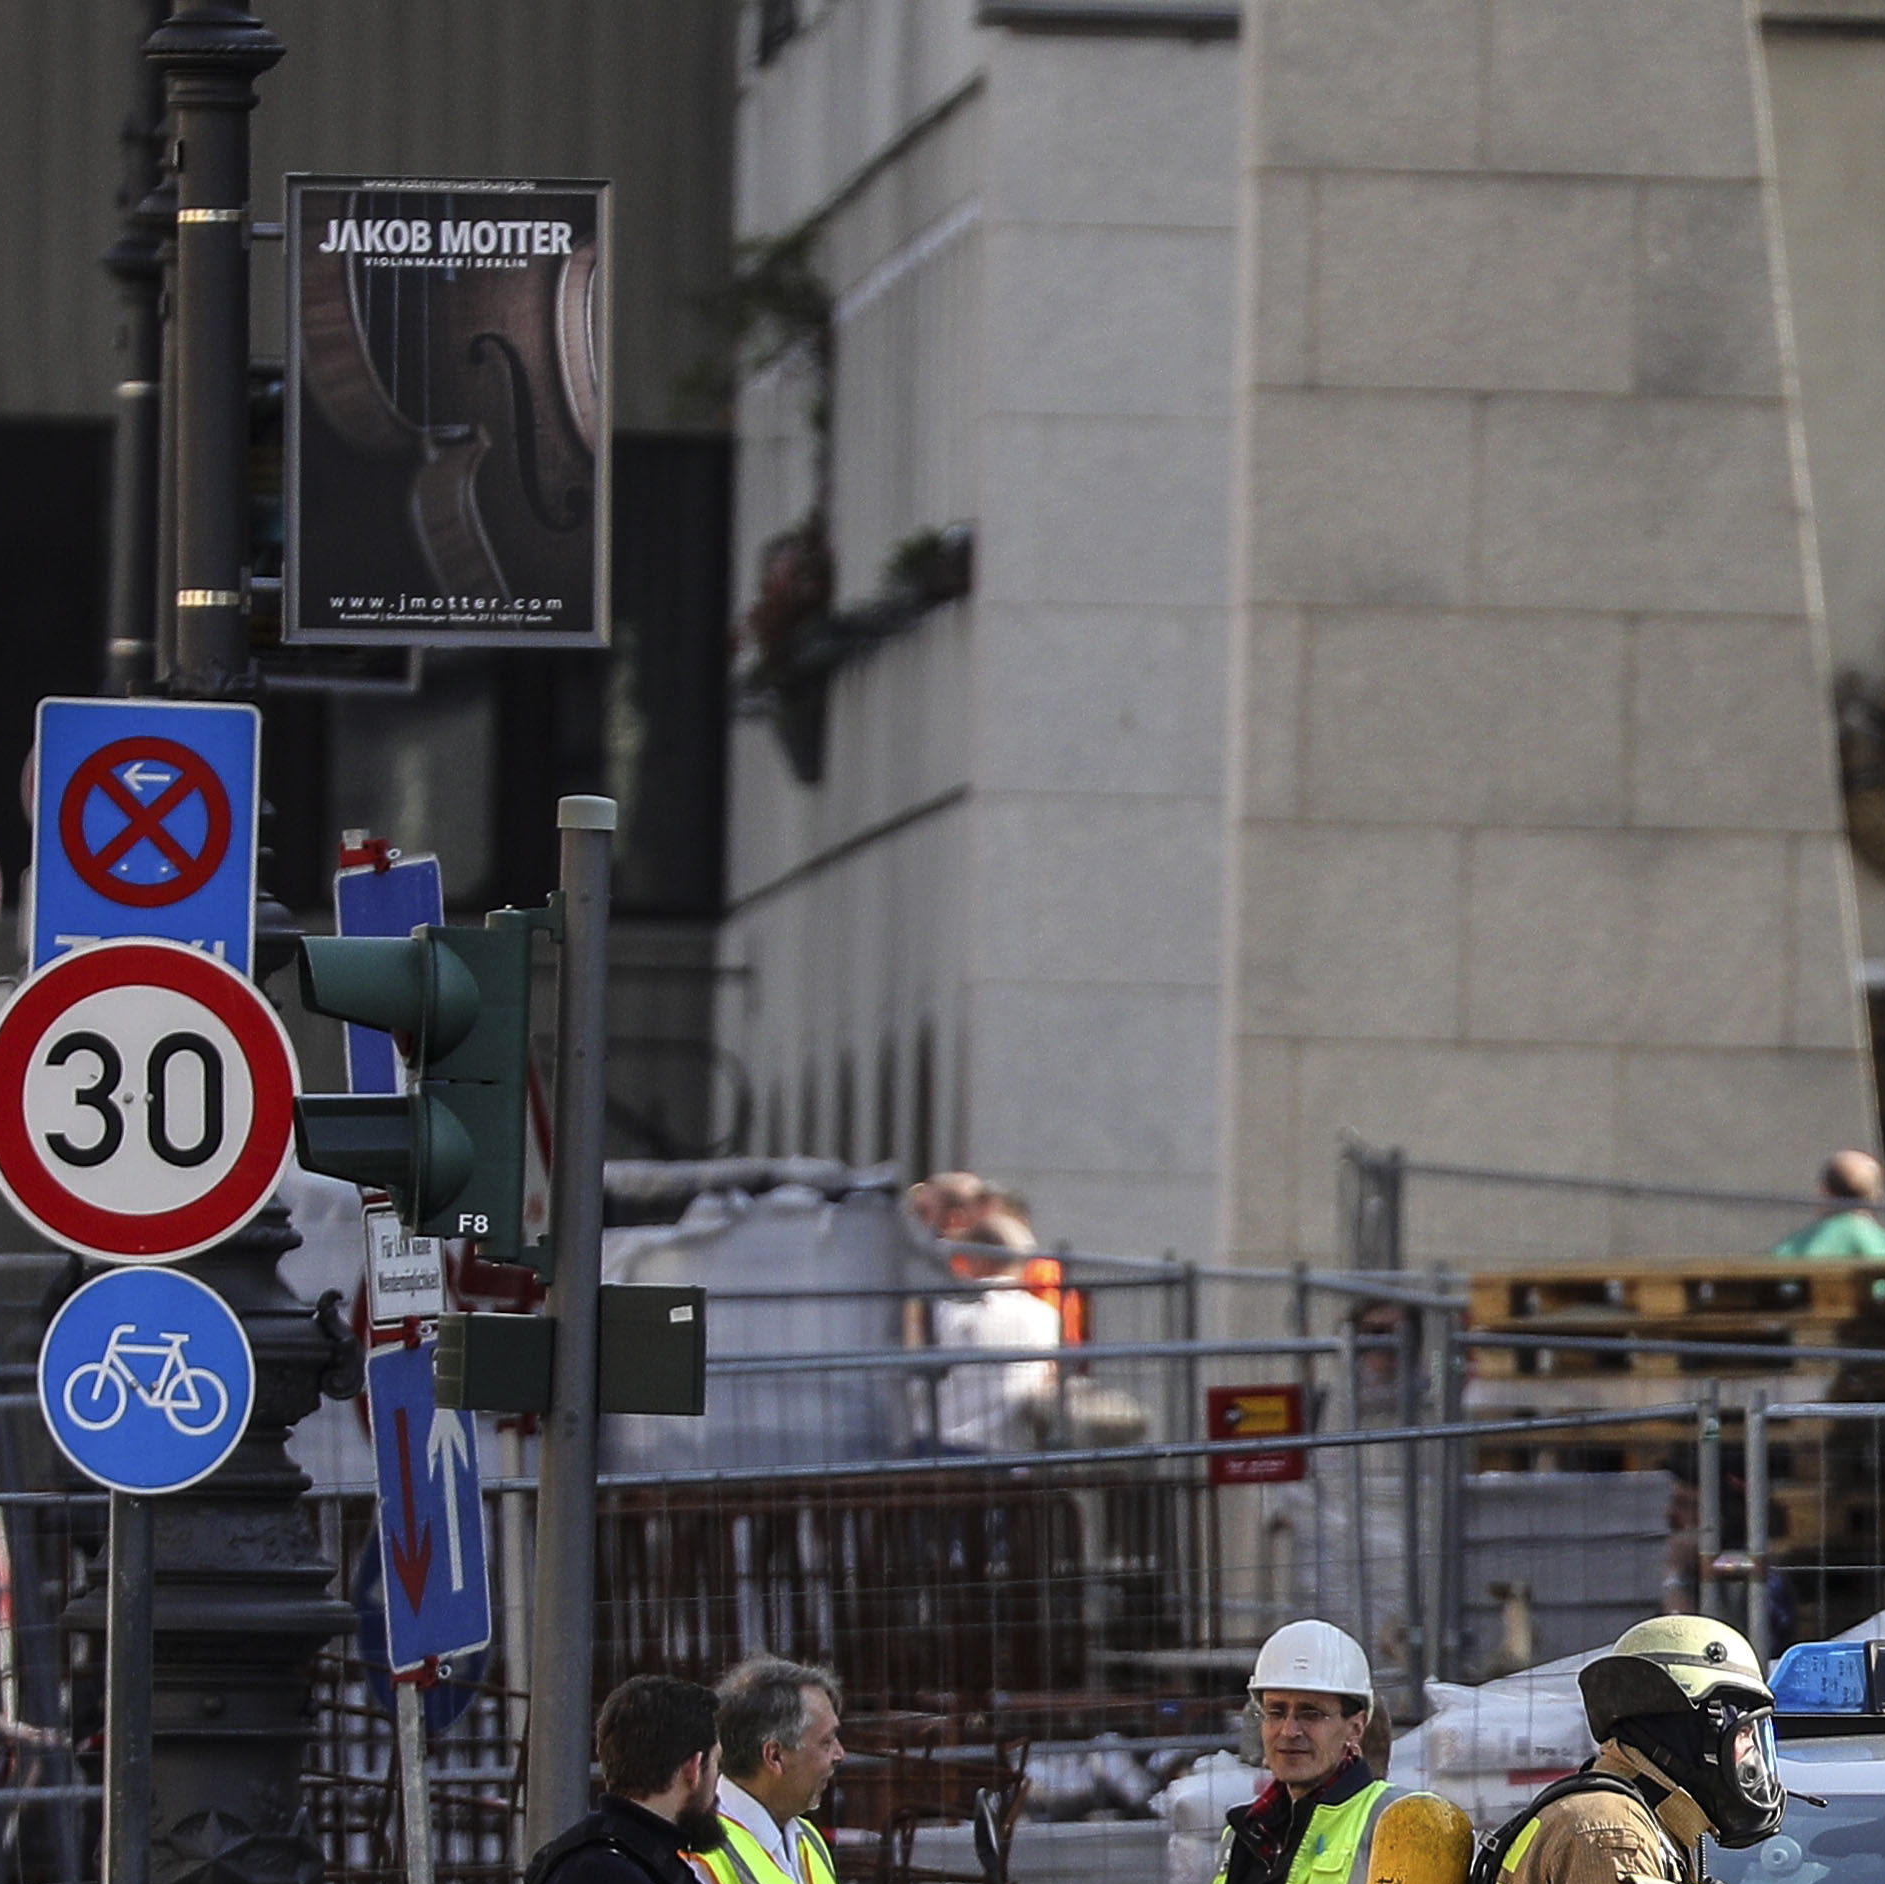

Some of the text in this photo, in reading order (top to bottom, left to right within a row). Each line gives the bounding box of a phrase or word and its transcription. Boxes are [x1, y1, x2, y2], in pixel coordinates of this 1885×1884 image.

[318, 218, 573, 255] JAKOB MOTTER
[364, 256, 528, 269] VIOLINMAKER BERLIN
[329, 593, 563, 612] www.jmotter.com
[44, 1031, 224, 1167] 30
[459, 1213, 489, 1234] F8
